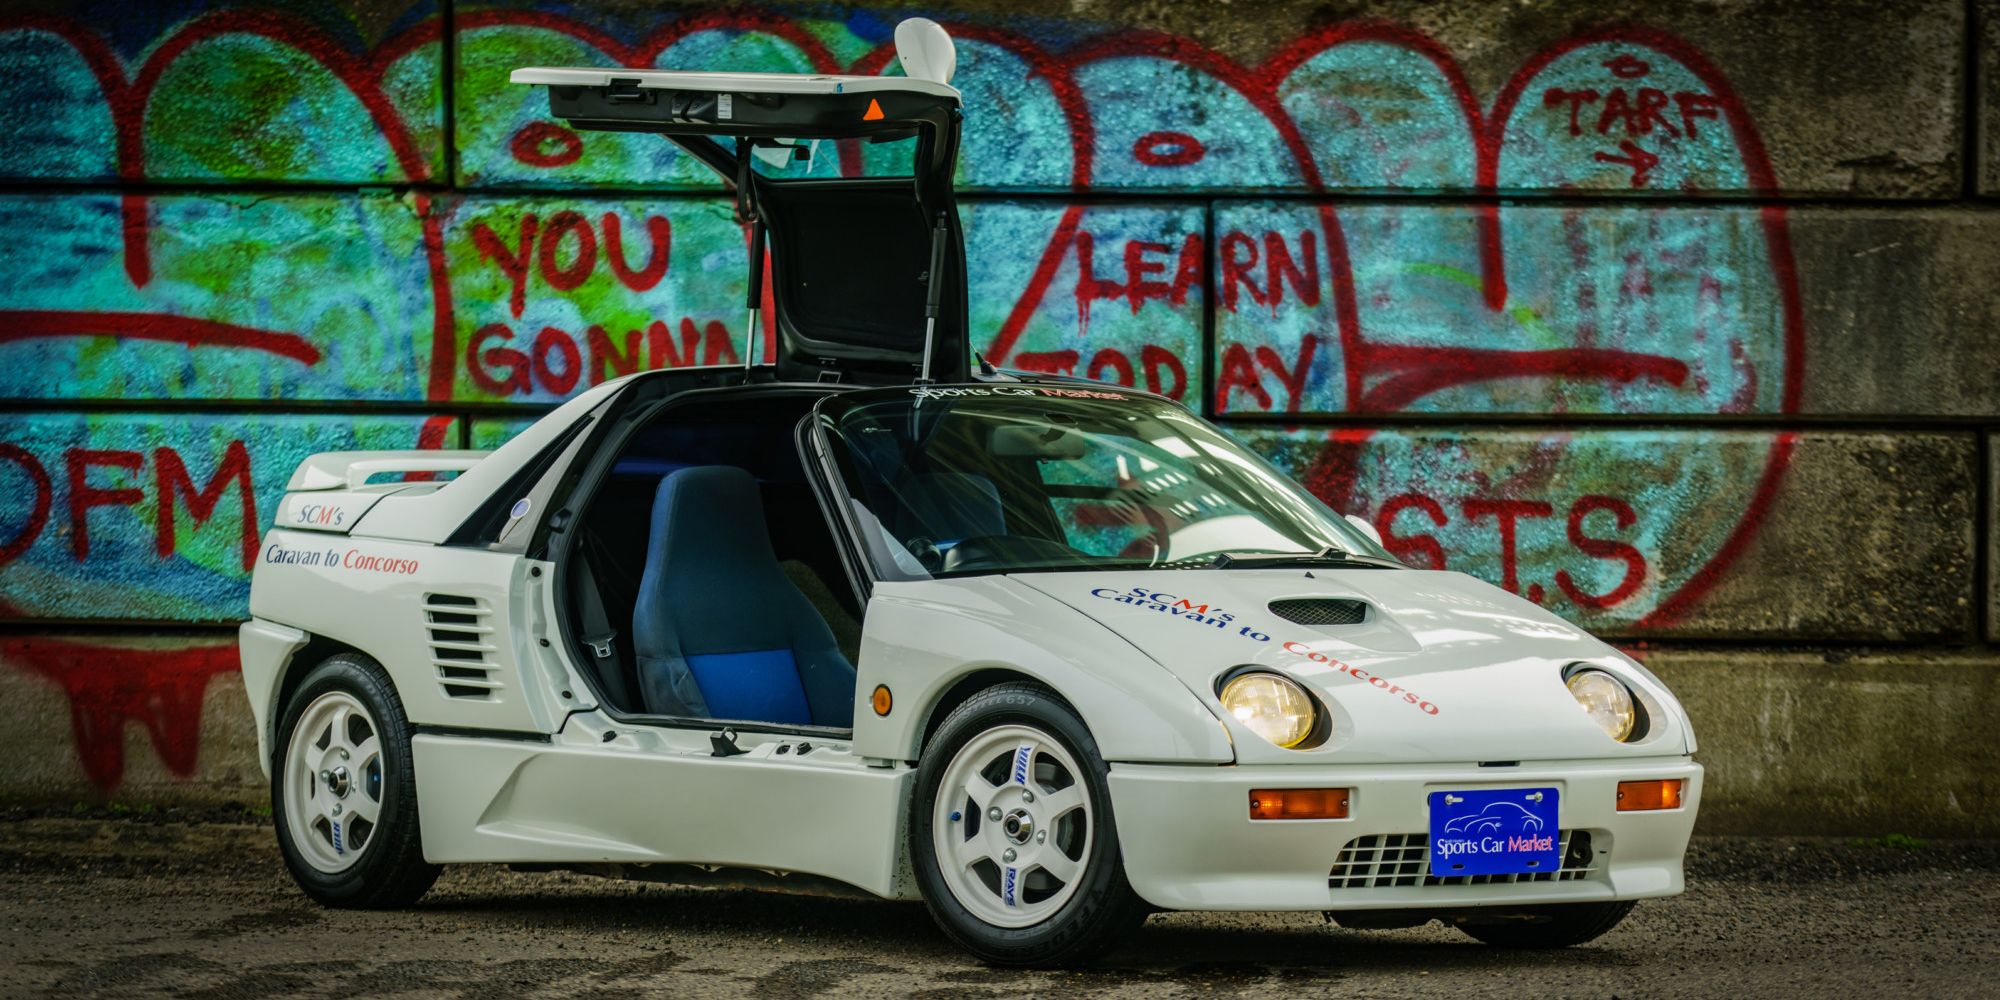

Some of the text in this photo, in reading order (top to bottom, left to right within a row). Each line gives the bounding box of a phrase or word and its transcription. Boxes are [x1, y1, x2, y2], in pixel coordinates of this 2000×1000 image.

[1543, 86, 1723, 140] TARF
[471, 210, 672, 320] YOU
[1074, 228, 1321, 322] LEARN
[465, 316, 740, 396] GONNA
[908, 386, 1129, 401] Sports Car Market
[297, 504, 344, 526] SCM's
[266, 543, 419, 575] Caravan to Concorso
[1128, 587, 1236, 623] SCM's
[1090, 588, 1439, 716] Caravan to Concorso
[1006, 694, 1036, 707] 657
[1437, 833, 1553, 860] Sports Car Market
[1007, 868, 1016, 907] RAYS
